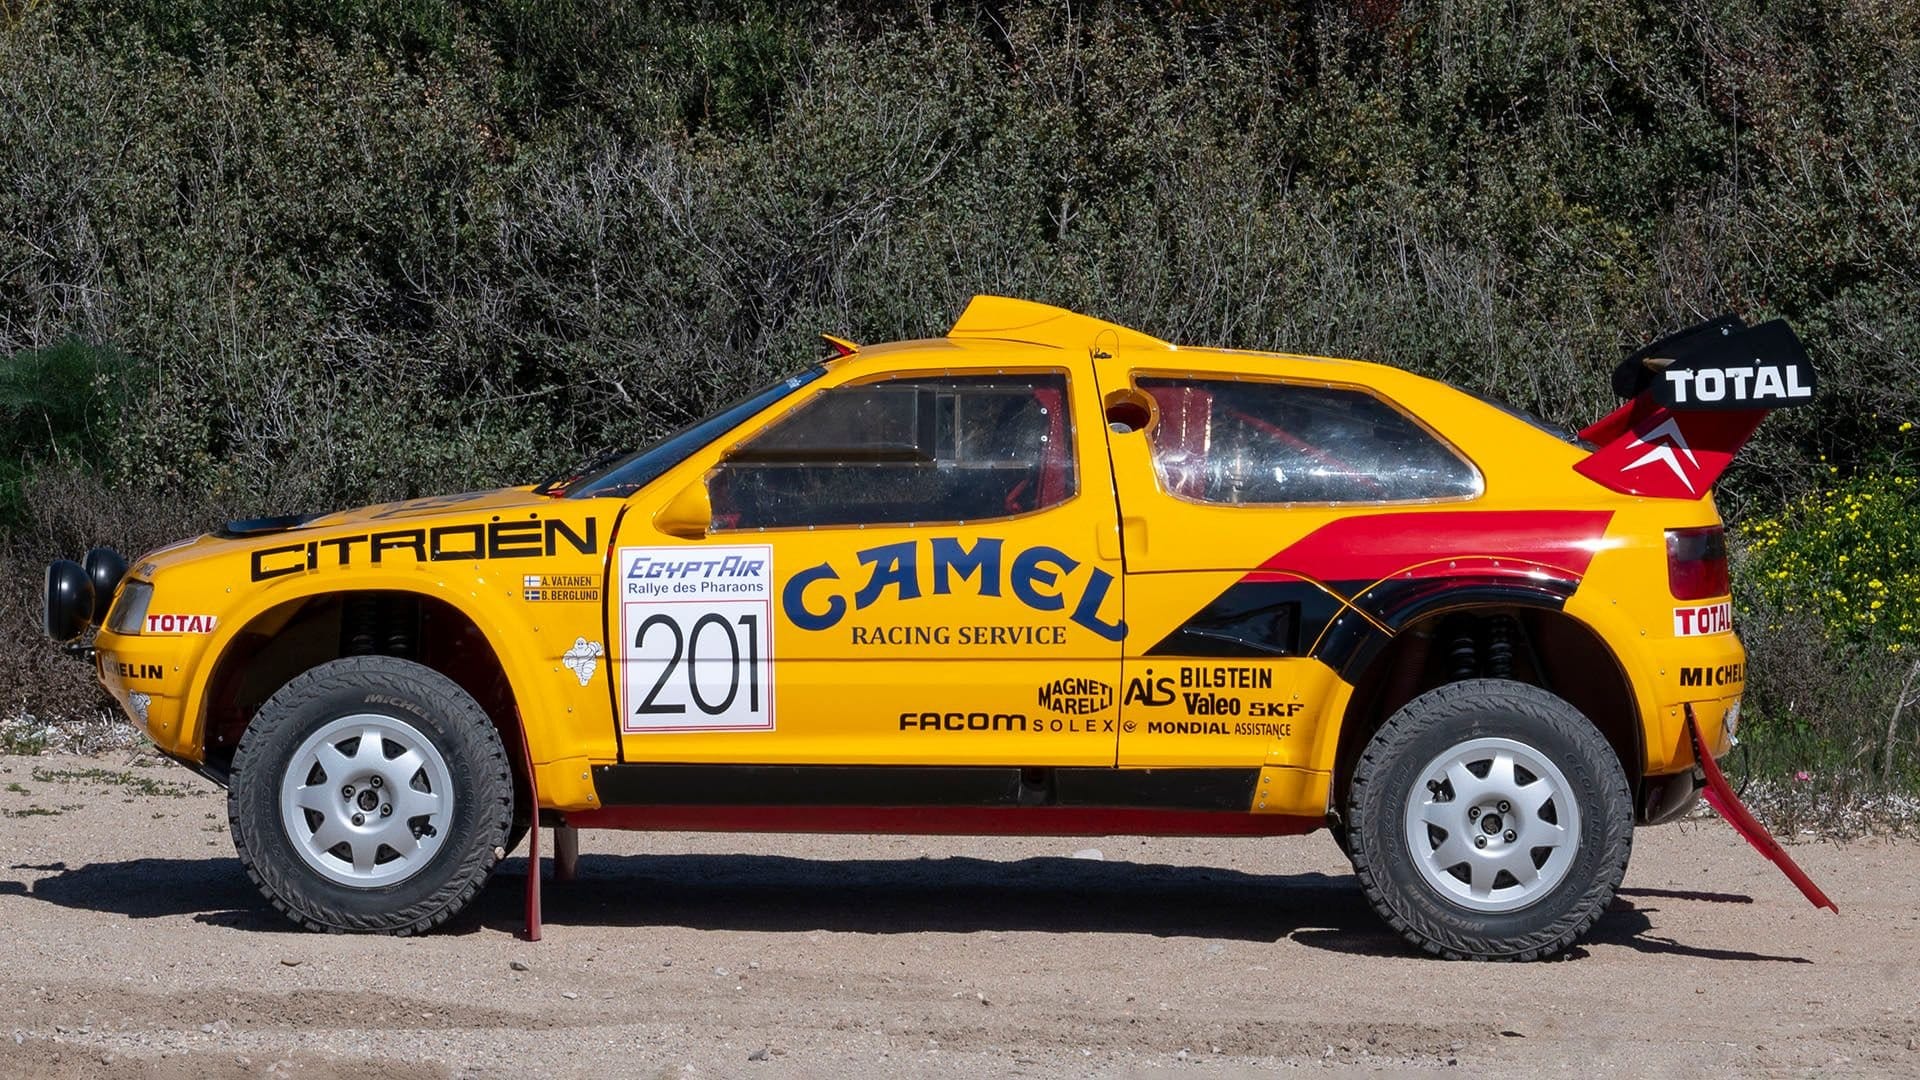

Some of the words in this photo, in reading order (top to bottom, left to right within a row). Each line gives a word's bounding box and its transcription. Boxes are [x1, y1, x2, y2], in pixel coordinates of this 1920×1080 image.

[1665, 364, 1812, 403] TOTAL
[251, 513, 597, 583] CITROËN
[628, 582, 669, 597] Rallye
[673, 582, 697, 594] des
[701, 581, 764, 593] Pharaons
[783, 537, 1129, 642] CAMEL
[148, 614, 214, 633] TOTAL
[1675, 604, 1731, 635] TOTAL
[853, 627, 951, 645] RACING
[958, 627, 1067, 645] SERVICE
[635, 612, 759, 716] 201
[1181, 667, 1273, 689] BILSTEIN
[1183, 692, 1241, 716] Valeo
[1248, 703, 1305, 717] SKF
[1033, 719, 1114, 732] SOLEX
[1148, 721, 1230, 735] MONDIAL
[1234, 722, 1292, 739] ASSISTANCE
